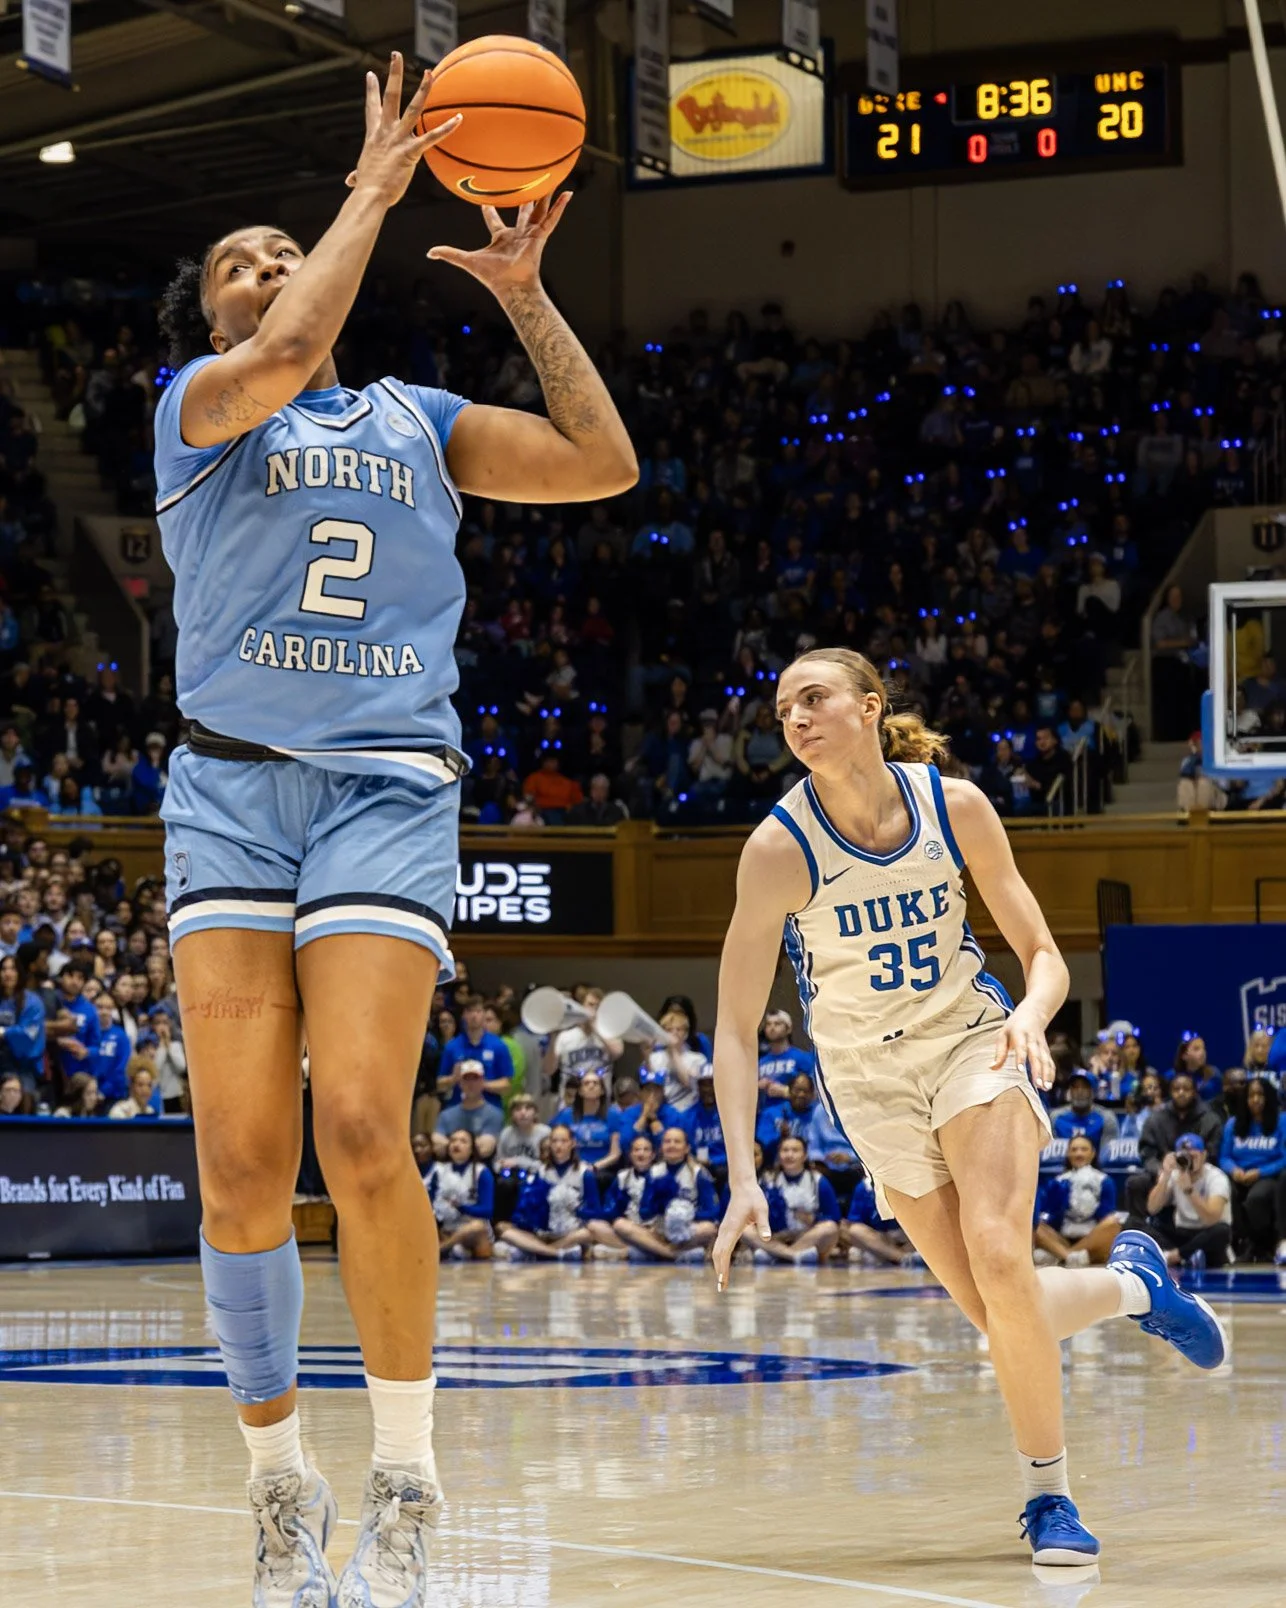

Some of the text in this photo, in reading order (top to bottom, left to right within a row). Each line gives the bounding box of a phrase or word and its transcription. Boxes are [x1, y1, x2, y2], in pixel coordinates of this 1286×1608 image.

[976, 78, 1052, 120] 8:36
[1095, 71, 1144, 93] UNC
[1097, 101, 1144, 141] 20
[877, 123, 921, 159] 21
[968, 134, 987, 164] 0
[1038, 128, 1057, 158] 0
[265, 446, 416, 510] NORTH
[127, 539, 148, 559] 12
[299, 517, 376, 621] 2
[239, 627, 424, 677] CAROLINA
[453, 896, 551, 922] IPES
[834, 881, 949, 937] DUKE
[868, 931, 941, 991] 35
[0, 1175, 186, 1207] Brands for Every Kind of Fan
